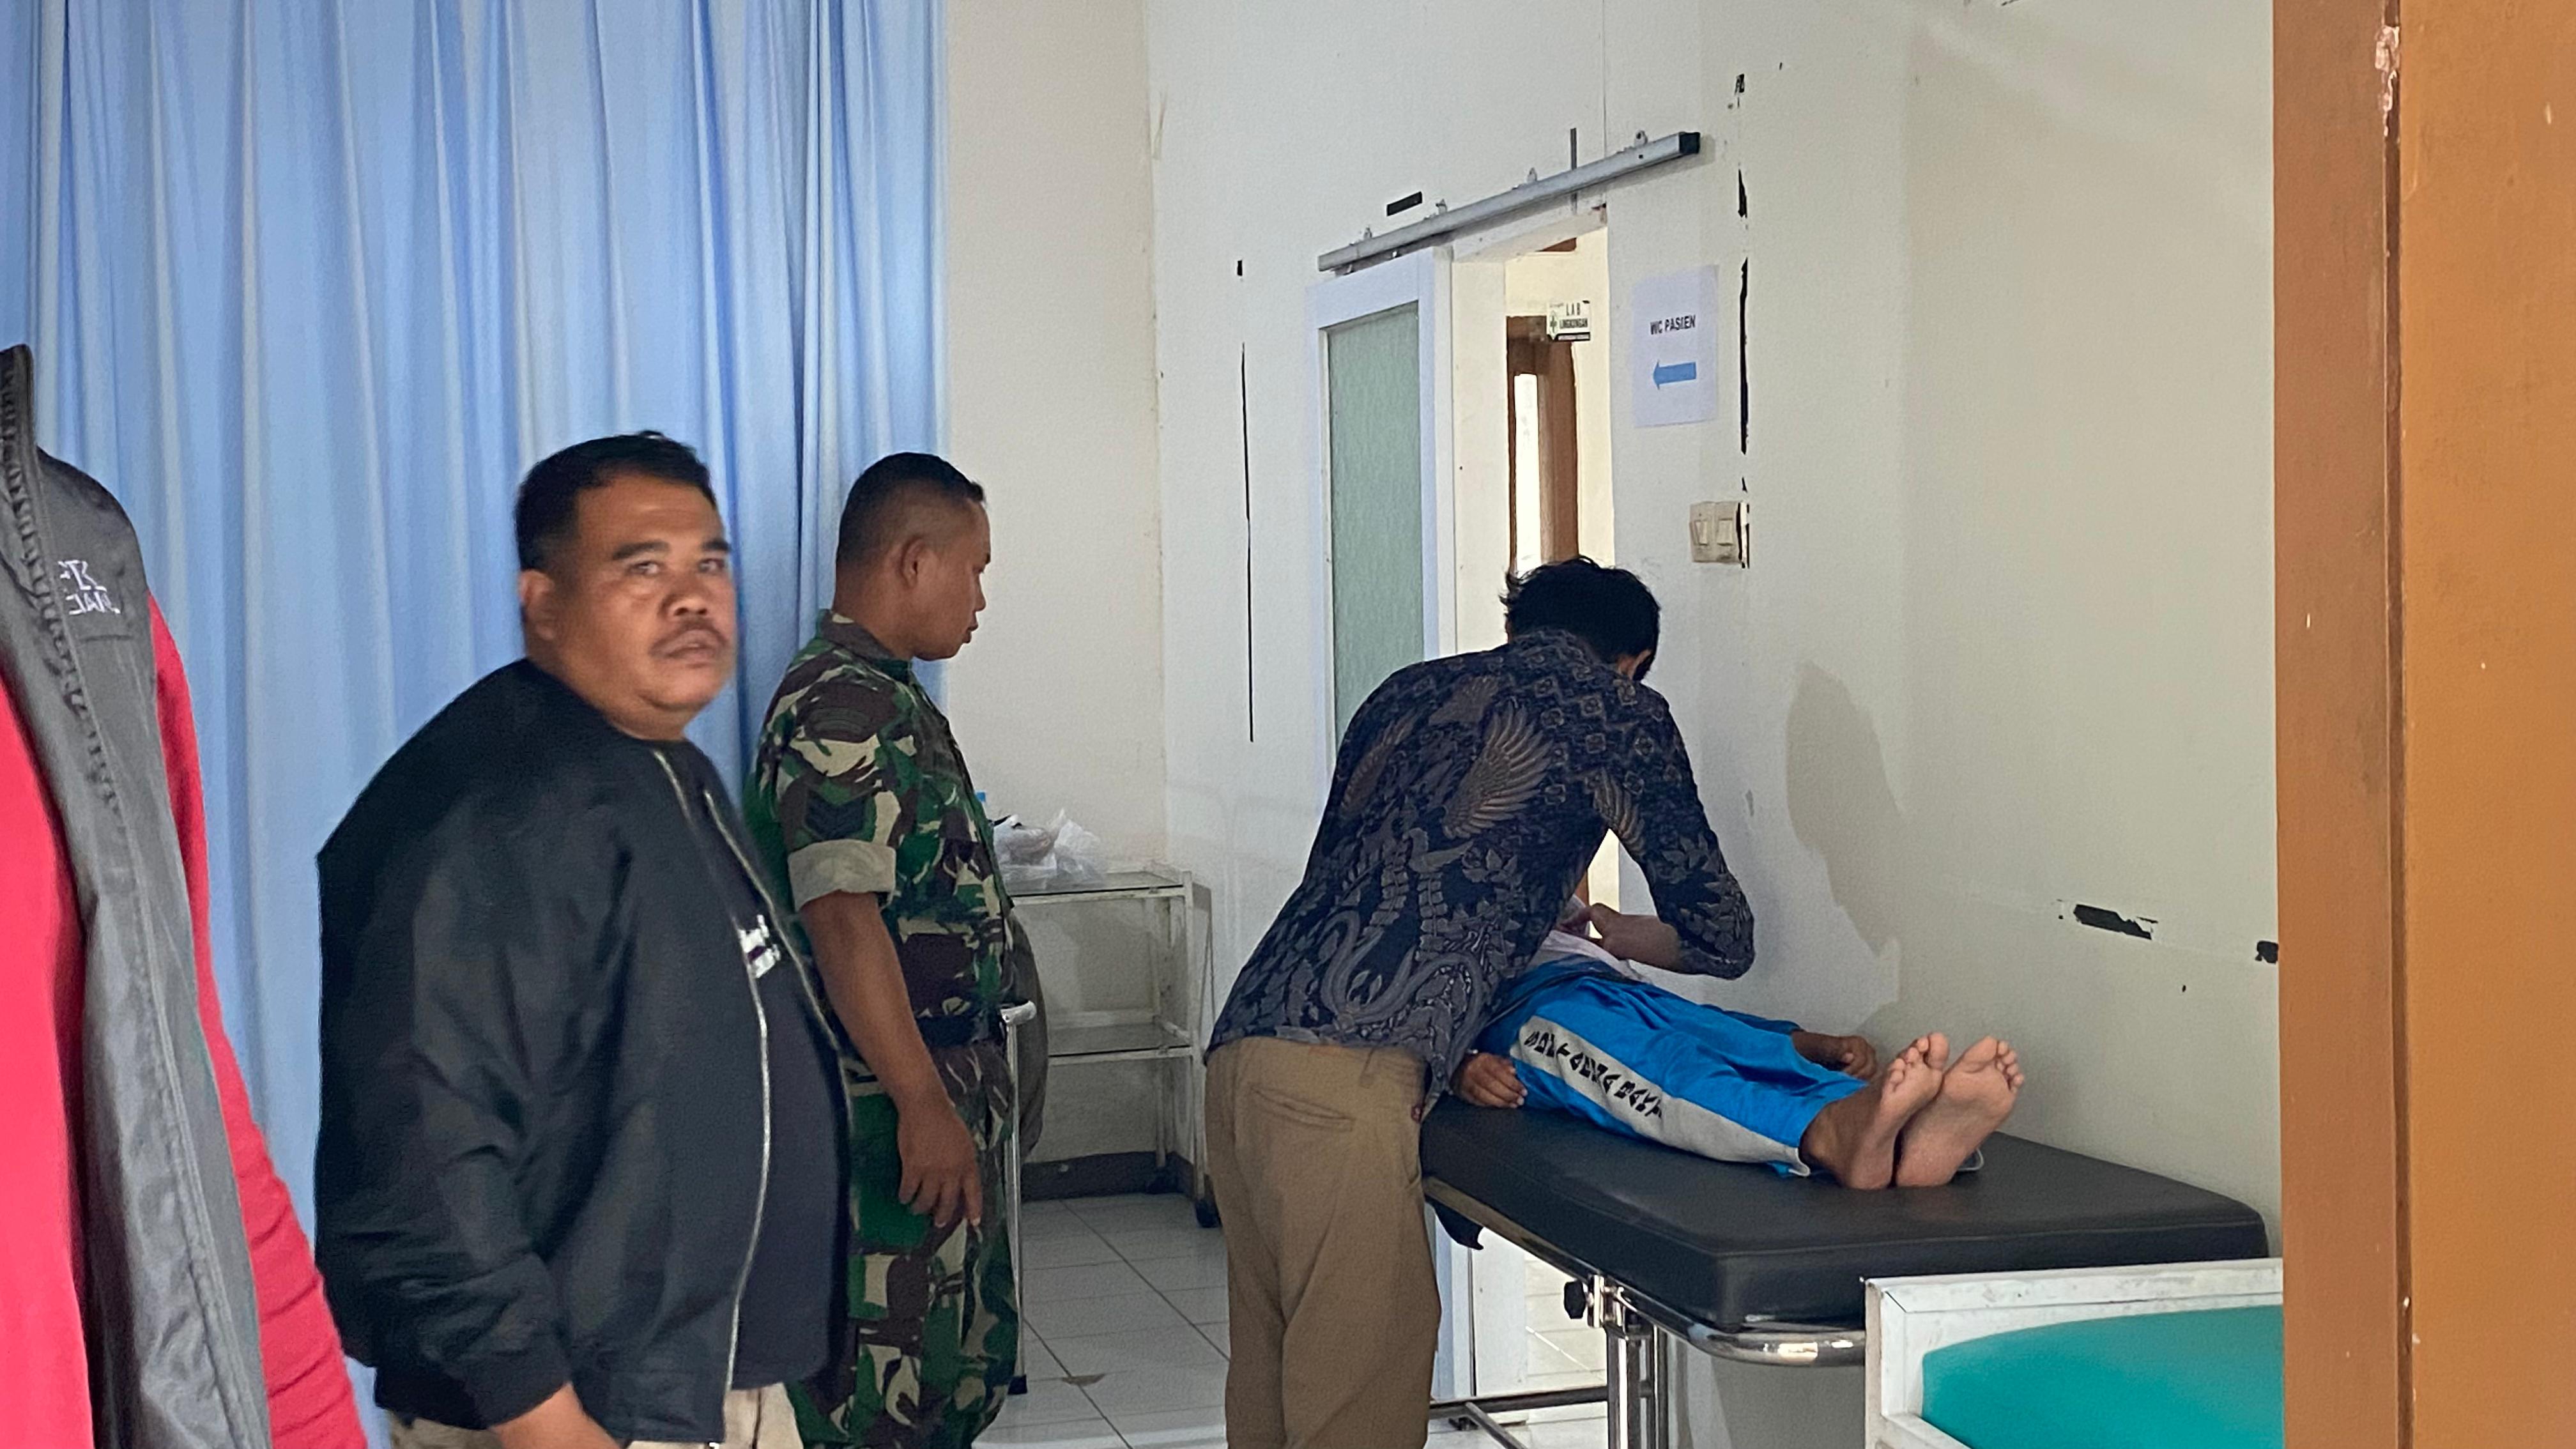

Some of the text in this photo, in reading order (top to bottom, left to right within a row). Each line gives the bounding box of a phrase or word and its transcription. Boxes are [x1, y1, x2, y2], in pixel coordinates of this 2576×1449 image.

[1566, 302, 1580, 316] LAB
[1650, 314, 1696, 335] WC PASIEN
